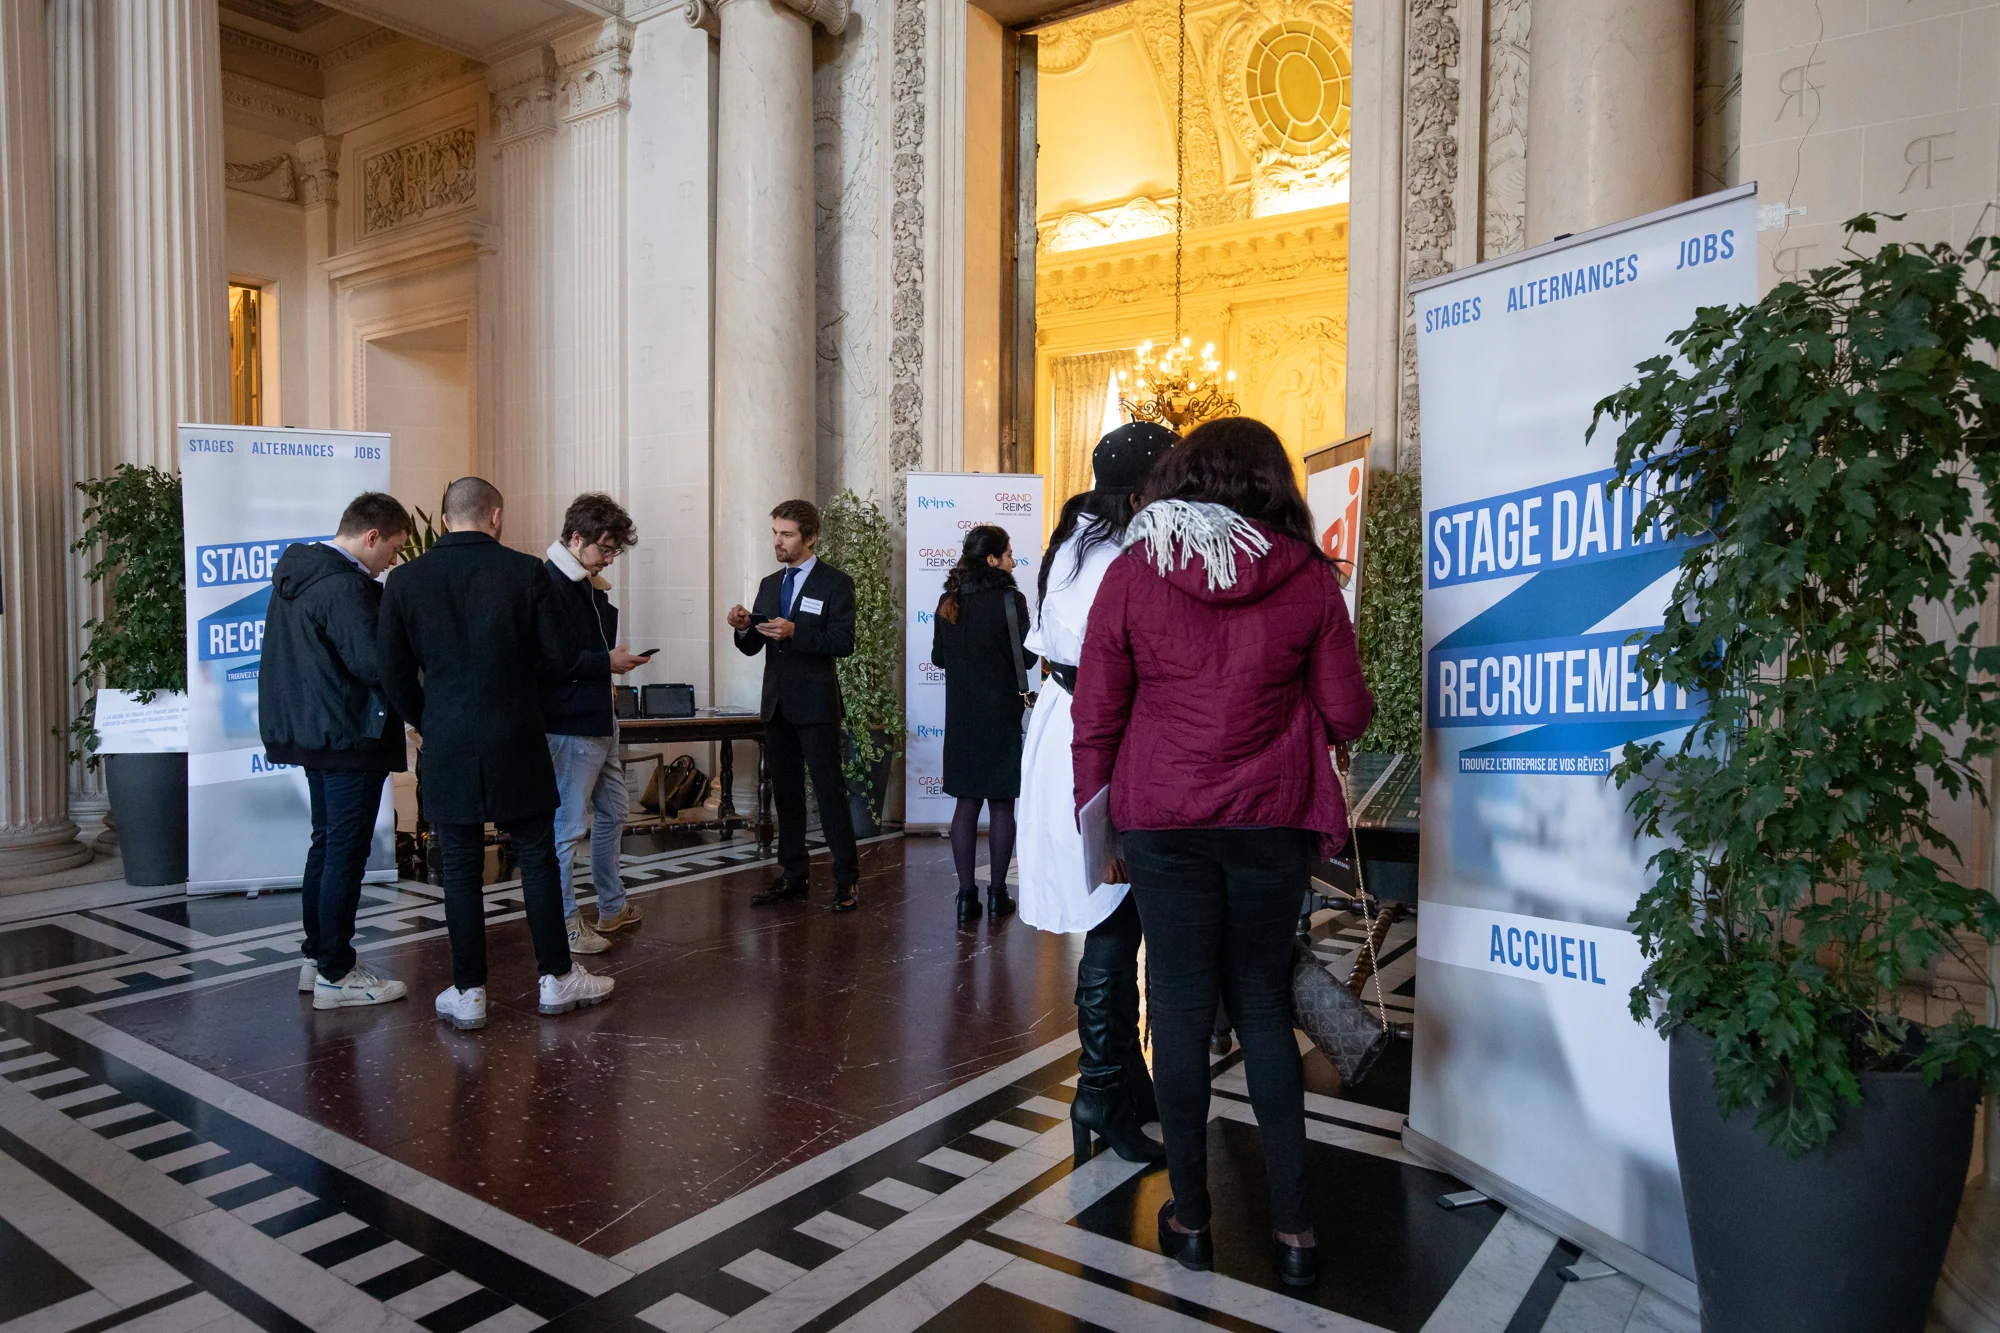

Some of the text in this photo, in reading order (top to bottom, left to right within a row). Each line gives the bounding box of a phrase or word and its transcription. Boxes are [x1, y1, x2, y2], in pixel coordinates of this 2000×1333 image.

[1425, 296, 1482, 334] STAGES
[1506, 254, 1639, 313] ALTERNANCES
[1676, 229, 1735, 271] JOBS
[189, 439, 381, 460] STAGES ALTERNANCES JOBS
[918, 495, 955, 510] Reims
[994, 492, 1032, 502] GRAND
[1002, 502, 1032, 512] REIMS
[1433, 462, 1712, 580] STAGE DATIN
[918, 548, 957, 558] GRAND
[201, 544, 280, 583] STAGE
[926, 558, 957, 567] REIMS
[228, 671, 251, 681] TROUVEZ
[1460, 757, 1495, 771] TROUVEZ
[1496, 757, 1546, 771] L'ENTREPRISE
[1547, 758, 1558, 772] DE
[1559, 758, 1576, 772] VOS
[1577, 755, 1604, 772] RÊVES
[1489, 924, 1606, 986] ACCUEIL
